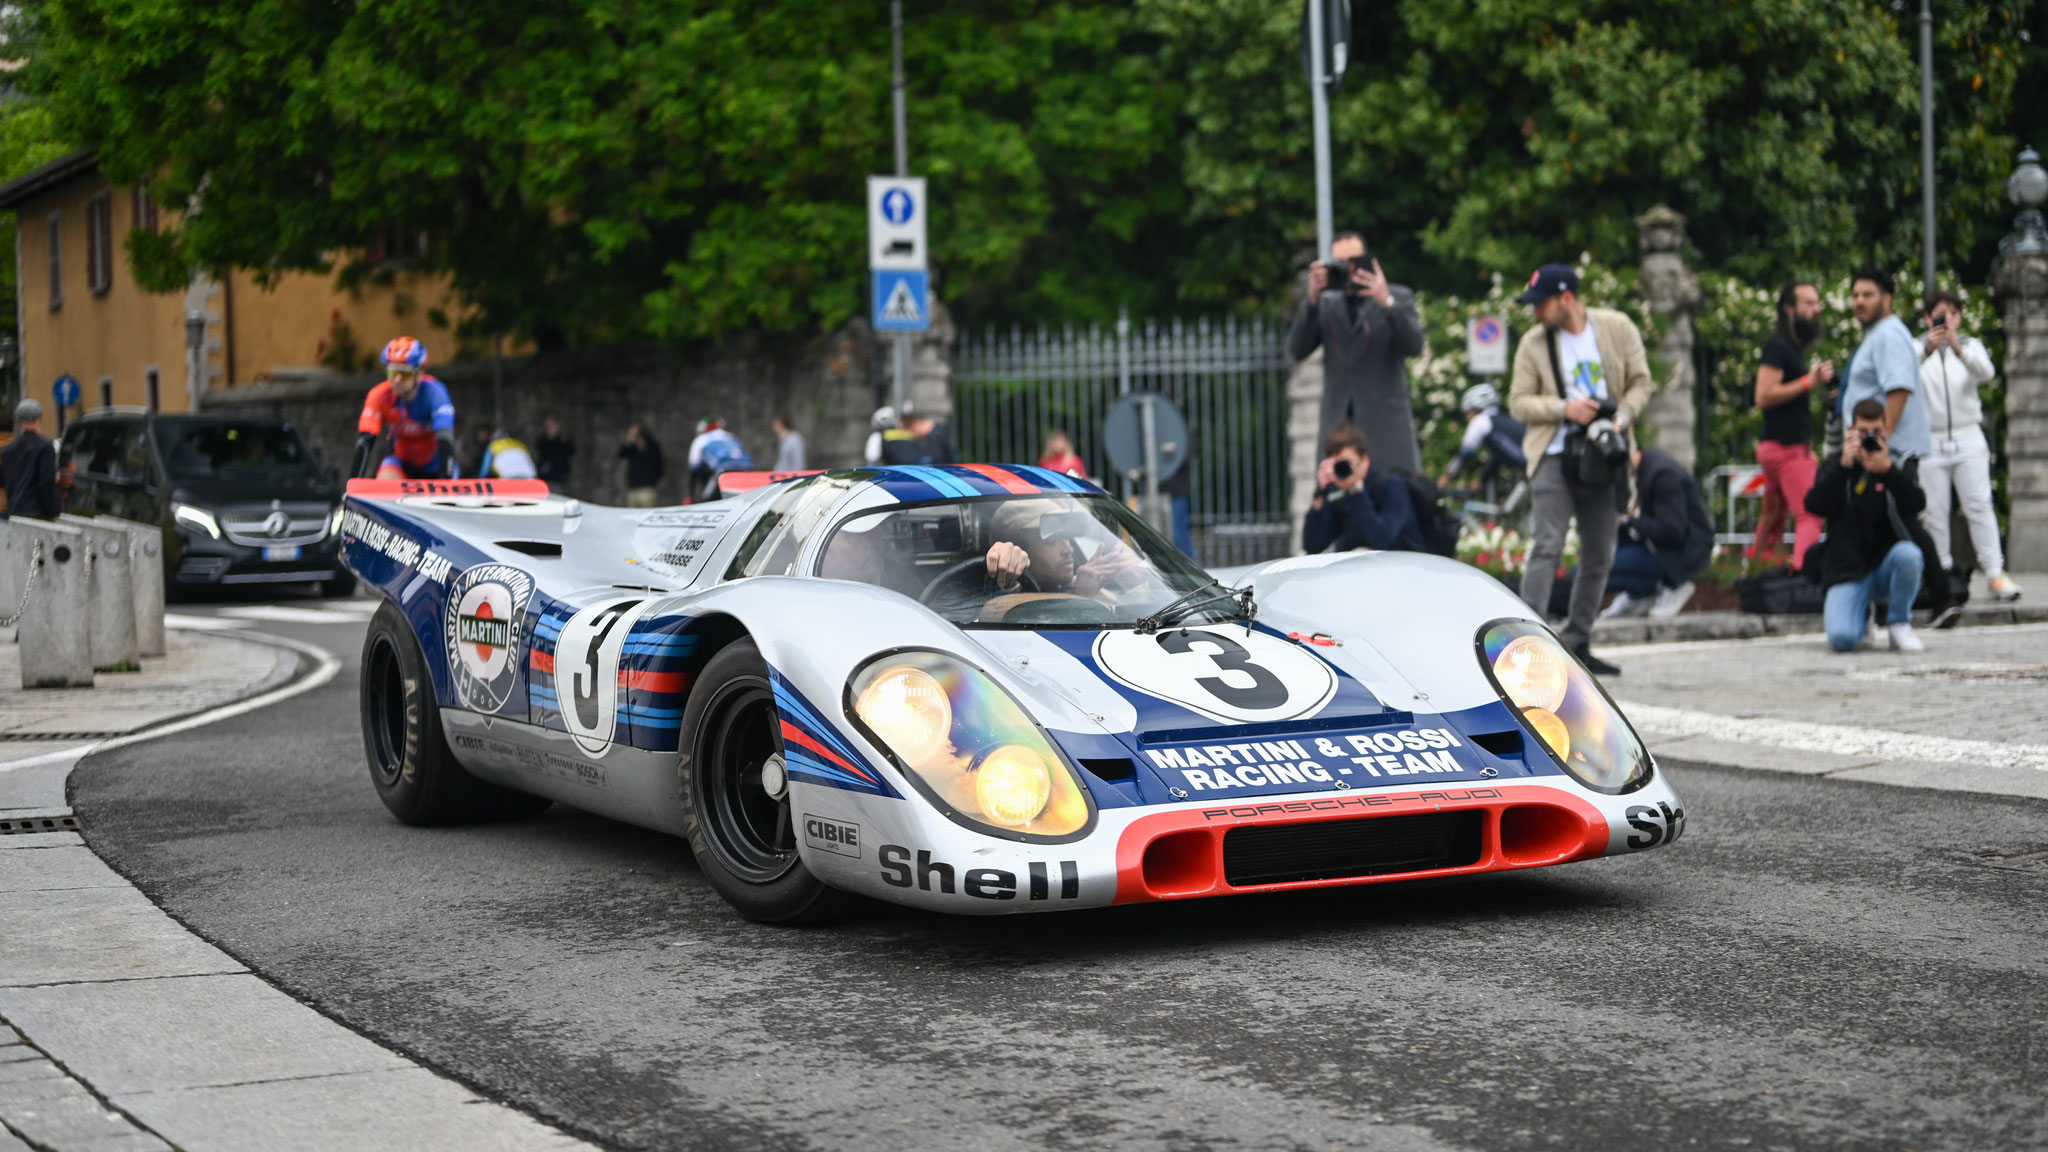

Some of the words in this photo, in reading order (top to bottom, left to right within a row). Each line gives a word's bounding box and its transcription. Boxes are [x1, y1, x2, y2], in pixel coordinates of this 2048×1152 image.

[401, 482, 494, 495] Shell
[366, 522, 391, 552] ROSSI
[385, 534, 420, 567] RACING
[416, 550, 453, 585] TEAM
[675, 539, 705, 551] ELFORD
[447, 583, 463, 670] MARTINI
[465, 565, 531, 616] INTERNATIONAL
[507, 621, 519, 675] CLUB
[461, 619, 507, 646] MARTINI
[574, 600, 645, 730] 3
[1156, 629, 1289, 710] 3
[455, 735, 486, 751] CIBIE
[1145, 739, 1312, 769] MARTINI
[1313, 736, 1349, 758] &
[1344, 728, 1462, 755] ROSSI
[576, 763, 600, 780] BOSCH
[1181, 761, 1334, 791] RACING
[1354, 750, 1464, 778] TEAM
[1202, 789, 1503, 821] PORSCHE-AUDI
[806, 819, 858, 846] CIBIE
[878, 844, 1079, 901] Shell
